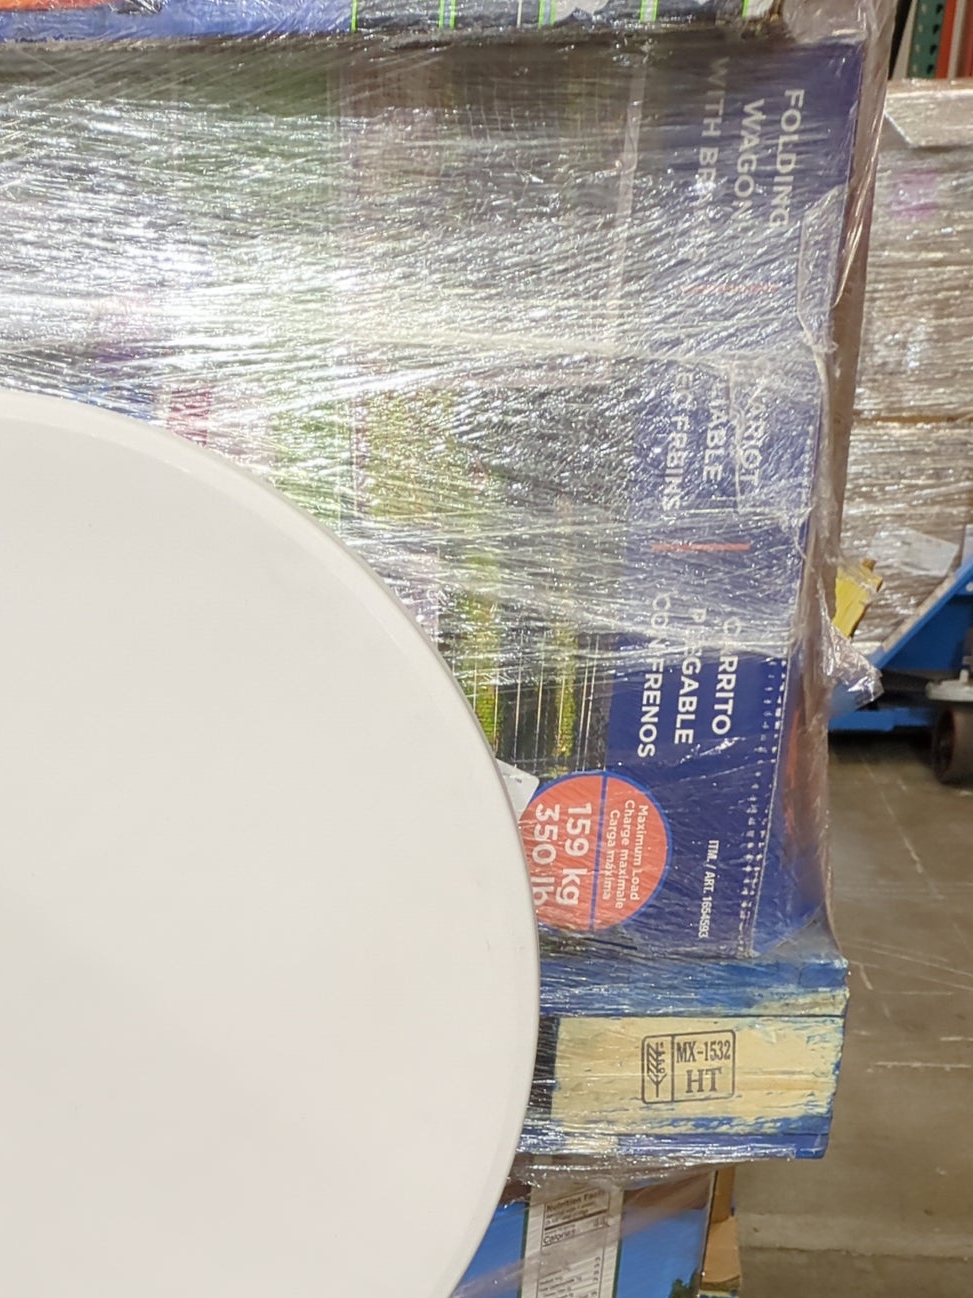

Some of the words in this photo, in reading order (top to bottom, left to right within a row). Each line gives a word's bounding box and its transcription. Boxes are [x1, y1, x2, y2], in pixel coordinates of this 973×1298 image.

[701, 57, 730, 137] WITH
[730, 98, 766, 221] WAGON
[769, 88, 805, 228] FOLDING
[674, 607, 708, 745] PEGABLE
[711, 616, 743, 736] CRRITO
[636, 657, 665, 758] FRENOS
[531, 804, 561, 865] 350
[564, 802, 592, 857] 159
[606, 809, 621, 847] Carga
[620, 800, 636, 846] Charge
[633, 804, 649, 866] Maximum
[601, 850, 618, 900] máxima
[706, 839, 719, 861] ITM.
[706, 862, 717, 870] /
[531, 876, 556, 906] lb
[555, 868, 588, 906] kg
[615, 849, 631, 909] maximale
[629, 868, 644, 901] Load
[703, 871, 718, 894] ART.
[676, 1040, 731, 1063] MX-1532
[685, 1066, 722, 1093] HT
